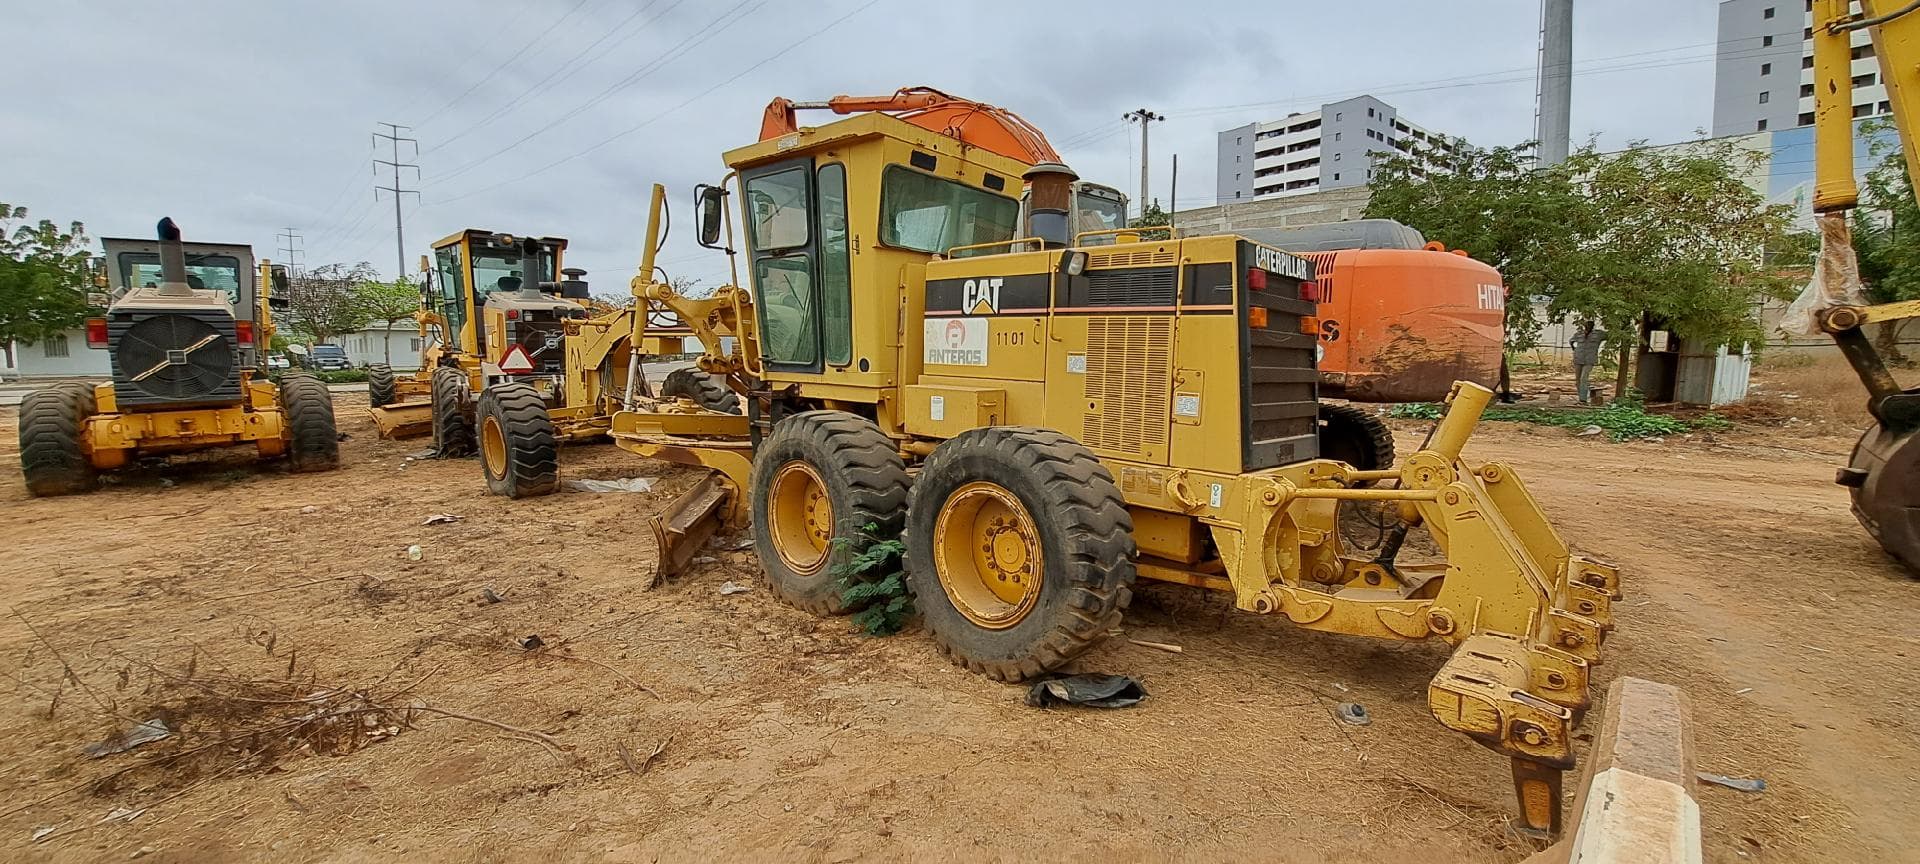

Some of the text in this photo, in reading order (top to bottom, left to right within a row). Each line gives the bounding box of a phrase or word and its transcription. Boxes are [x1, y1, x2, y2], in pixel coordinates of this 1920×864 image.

[1256, 245, 1307, 280] CATERPILLAR
[962, 278, 1003, 315] CAT
[996, 332, 1024, 346] 1101
[929, 349, 982, 365] ANTEROS
